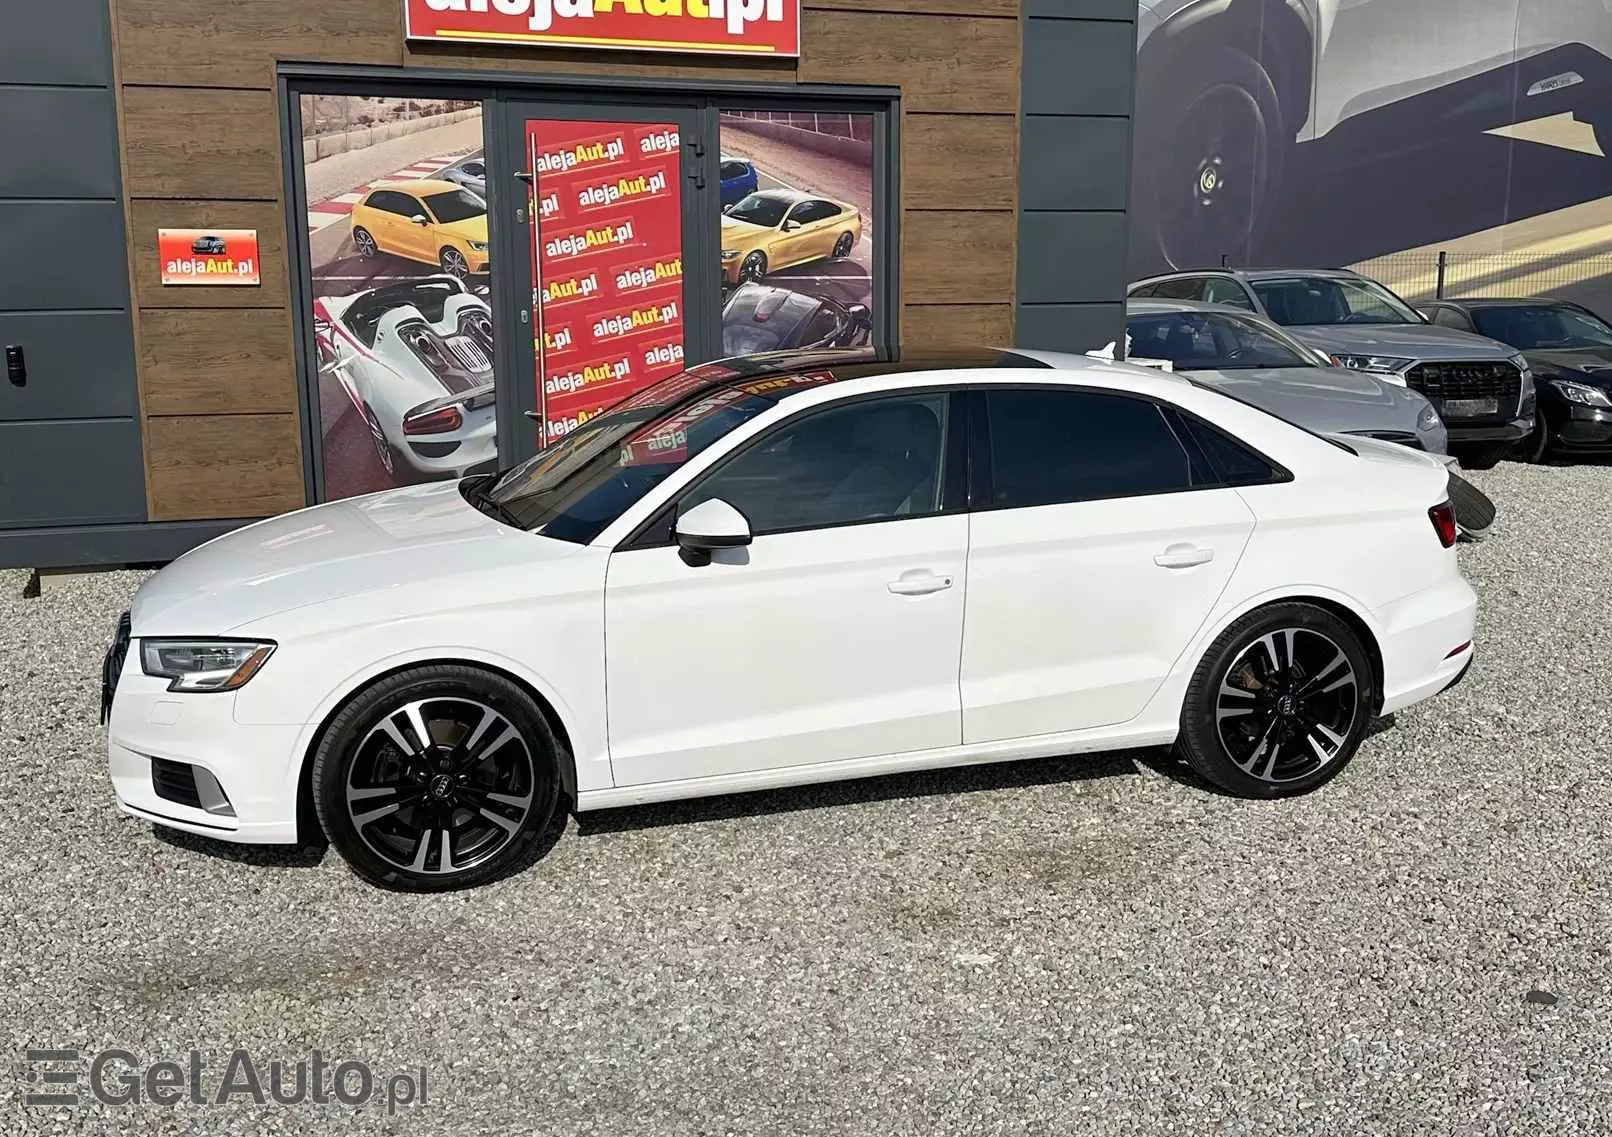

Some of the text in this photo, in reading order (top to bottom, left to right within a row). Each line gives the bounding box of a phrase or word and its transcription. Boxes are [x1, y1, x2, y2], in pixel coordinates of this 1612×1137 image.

[536, 138, 624, 171] alejaAut.pl
[579, 172, 666, 205] alejaAut.pl
[546, 222, 633, 256] alejaAut.pl
[167, 258, 253, 276] alejaAut.pl
[592, 302, 678, 337] alejaAut.pl
[545, 357, 631, 394] alejaAut.pl
